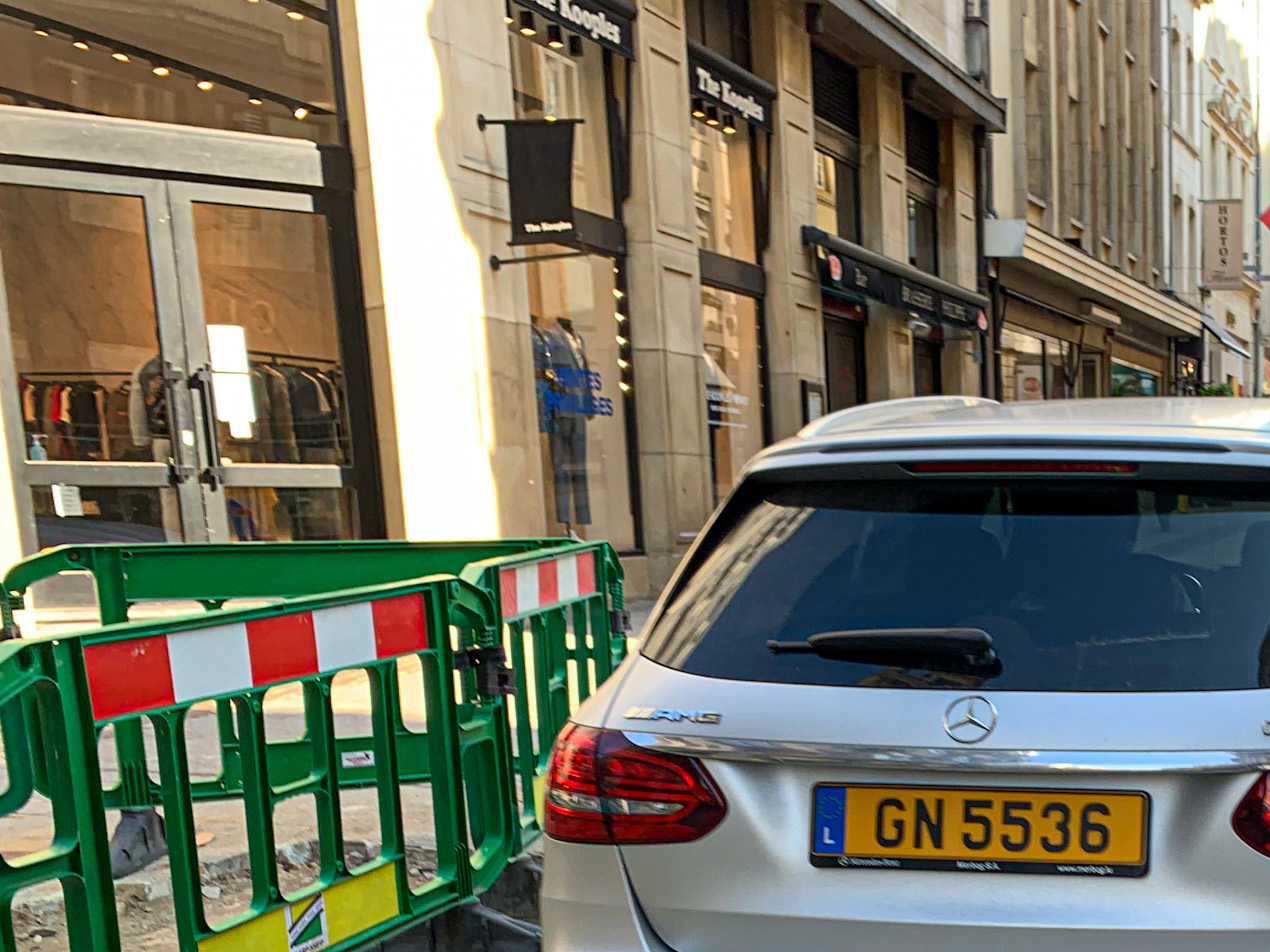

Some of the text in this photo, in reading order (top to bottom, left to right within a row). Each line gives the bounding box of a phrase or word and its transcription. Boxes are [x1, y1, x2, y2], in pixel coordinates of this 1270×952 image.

[696, 66, 764, 122] The Kooples
[523, 220, 573, 233] The Kooples
[1218, 205, 1229, 267] HORTOS
[650, 707, 722, 724] AMG
[822, 826, 836, 845] L
[875, 797, 1111, 854] GN 5536
